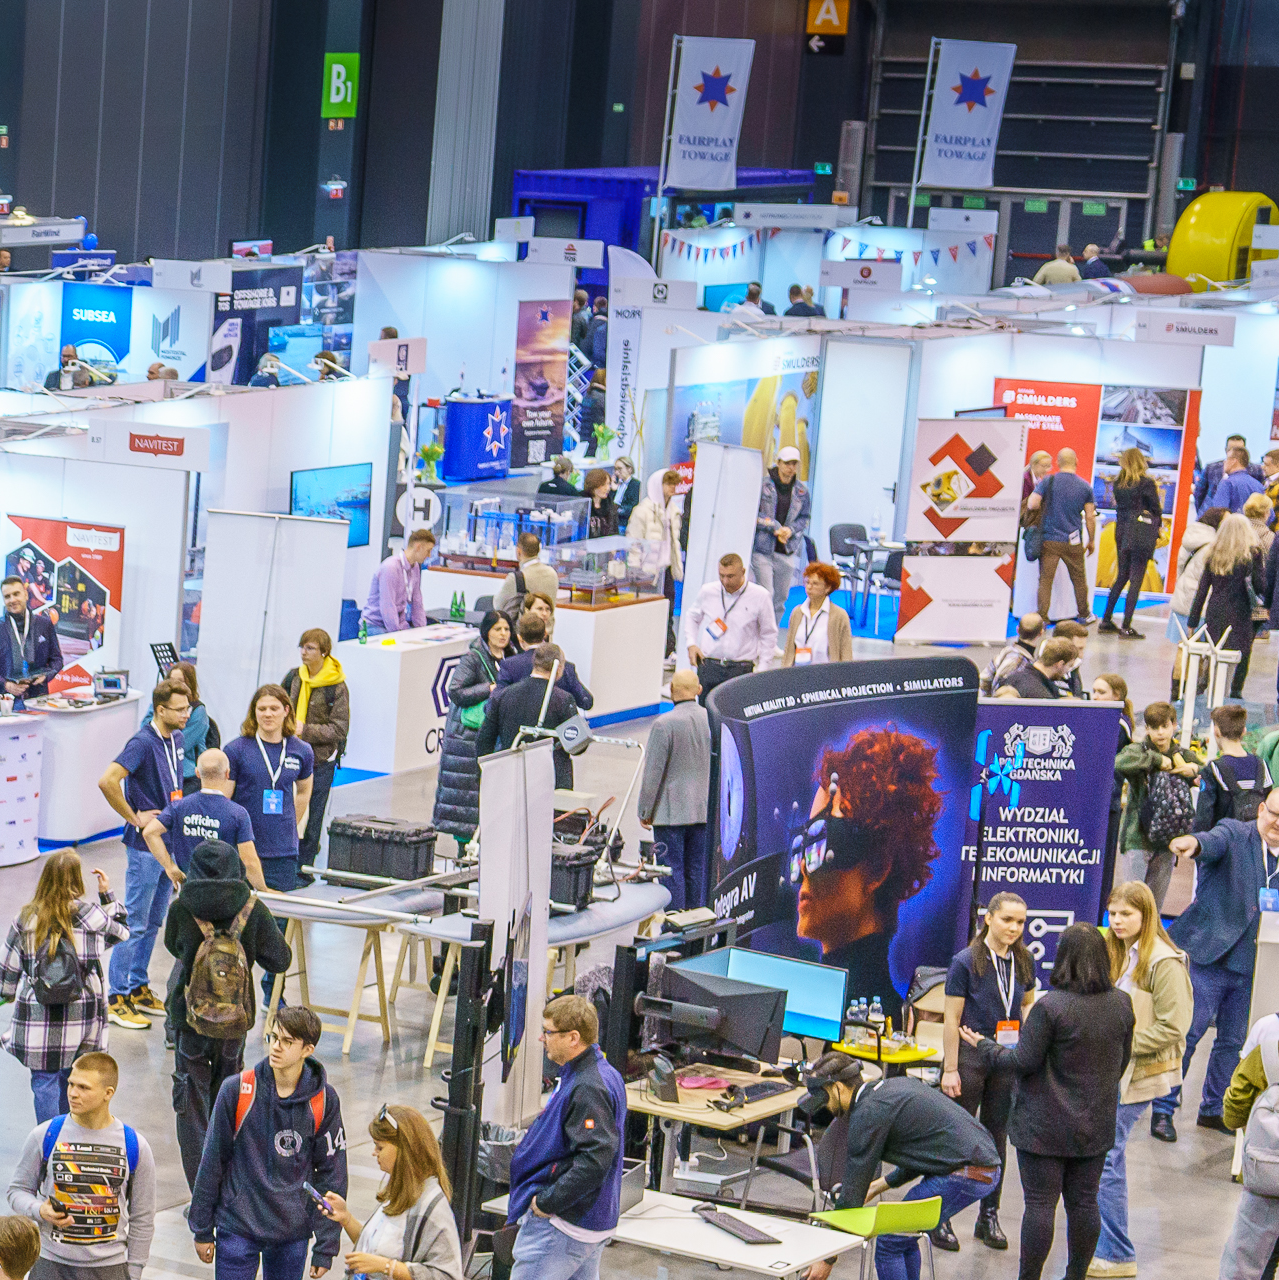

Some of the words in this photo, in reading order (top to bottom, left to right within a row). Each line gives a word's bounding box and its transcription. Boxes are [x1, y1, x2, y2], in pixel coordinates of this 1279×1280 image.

[815, 0, 840, 25] A
[330, 64, 352, 103] B1
[678, 133, 735, 148] FAIRPLAY
[934, 133, 991, 148] FAIRPLAY
[680, 149, 732, 162] TOWAGE
[936, 148, 988, 161] TOWAGE
[72, 308, 116, 323] SUBSEA
[1175, 325, 1218, 335] SMULDERS
[1016, 393, 1078, 408] SMULDERS
[1015, 412, 1061, 423] PASSIONATE
[134, 438, 179, 452] NAVITEST
[72, 532, 114, 547] NAVITEST
[743, 704, 764, 718] VIRTUAL
[764, 698, 785, 712] REALITY
[785, 696, 795, 707] 3D
[801, 688, 841, 704] SPHERICAL
[841, 682, 894, 698] PROJECTION
[903, 677, 964, 692] SIMULATORS
[183, 814, 220, 828] officina
[998, 806, 1069, 824] WYDZIAŁ
[961, 845, 1101, 865] TEEKOMUNIKACJI
[981, 865, 1085, 885] INFORMATYKI
[741, 871, 757, 903] AV
[325, 1128, 346, 1157] 14
